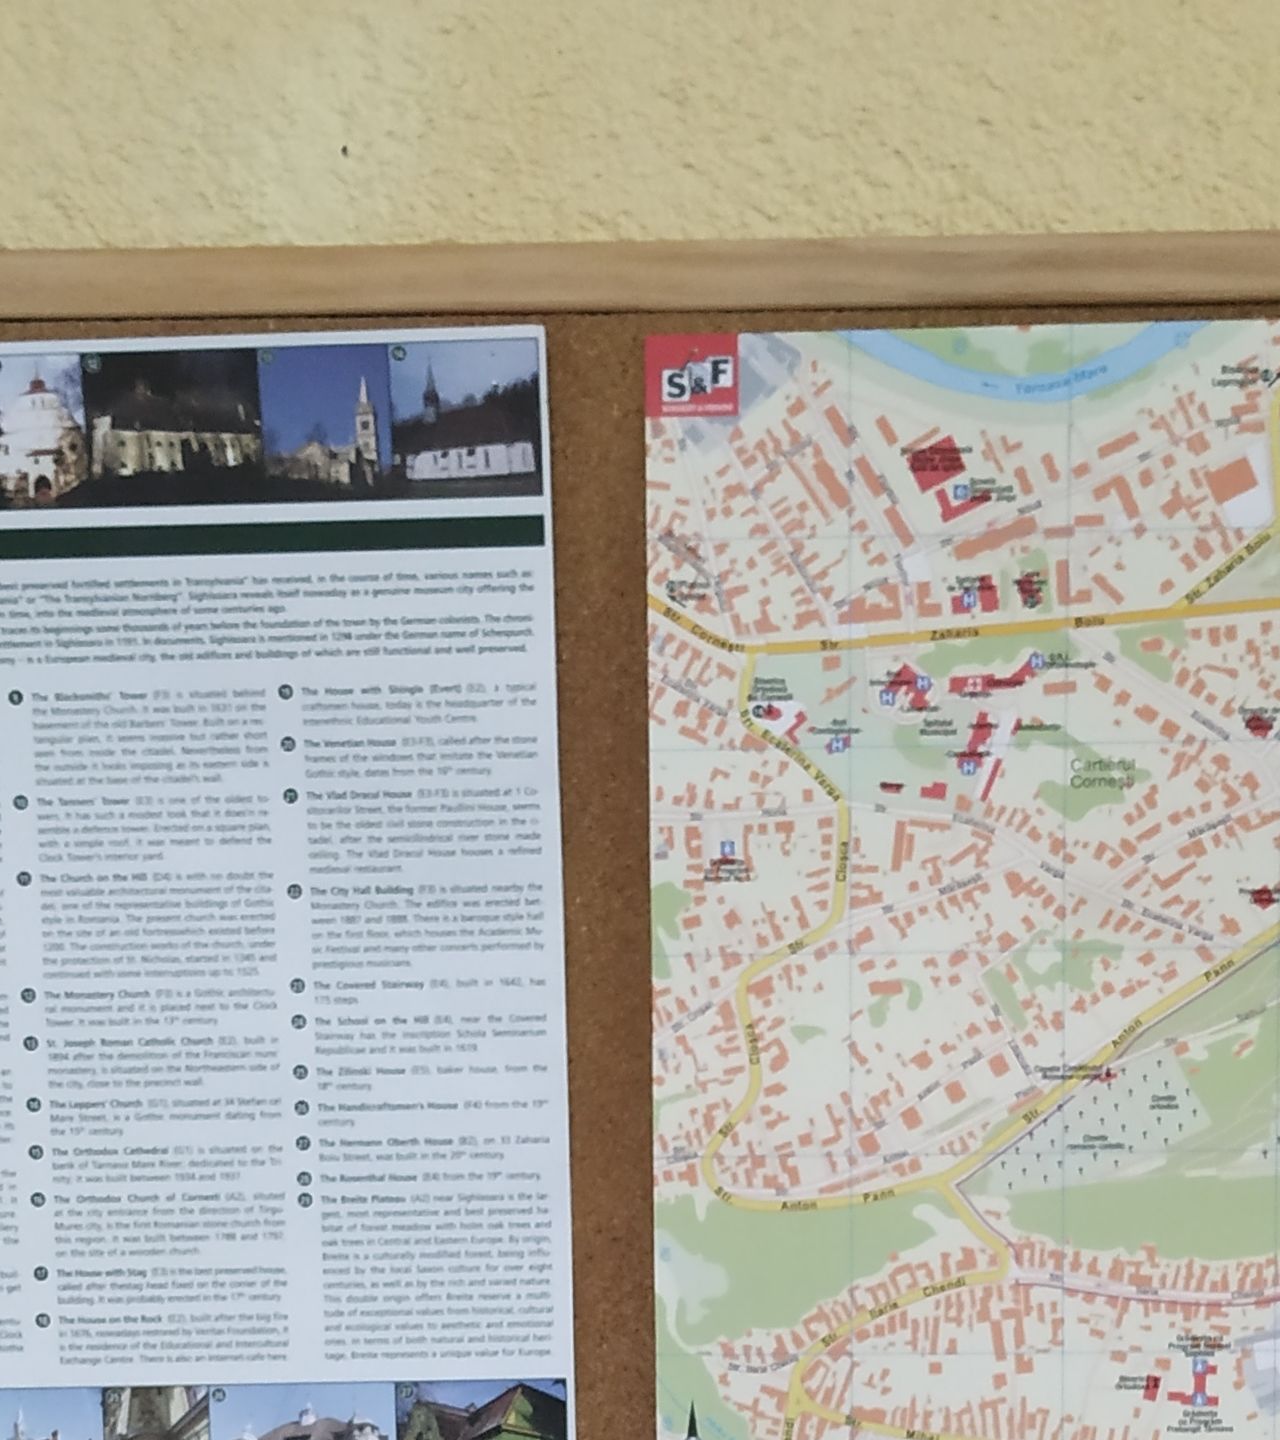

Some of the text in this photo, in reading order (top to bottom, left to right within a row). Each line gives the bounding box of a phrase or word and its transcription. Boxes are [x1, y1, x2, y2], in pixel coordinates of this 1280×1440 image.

[1070, 758, 1136, 772] Cartierul
[1111, 1018, 1144, 1048] Anton
[781, 1189, 895, 1211] Anton Pann
[922, 1276, 966, 1297] Chendi
